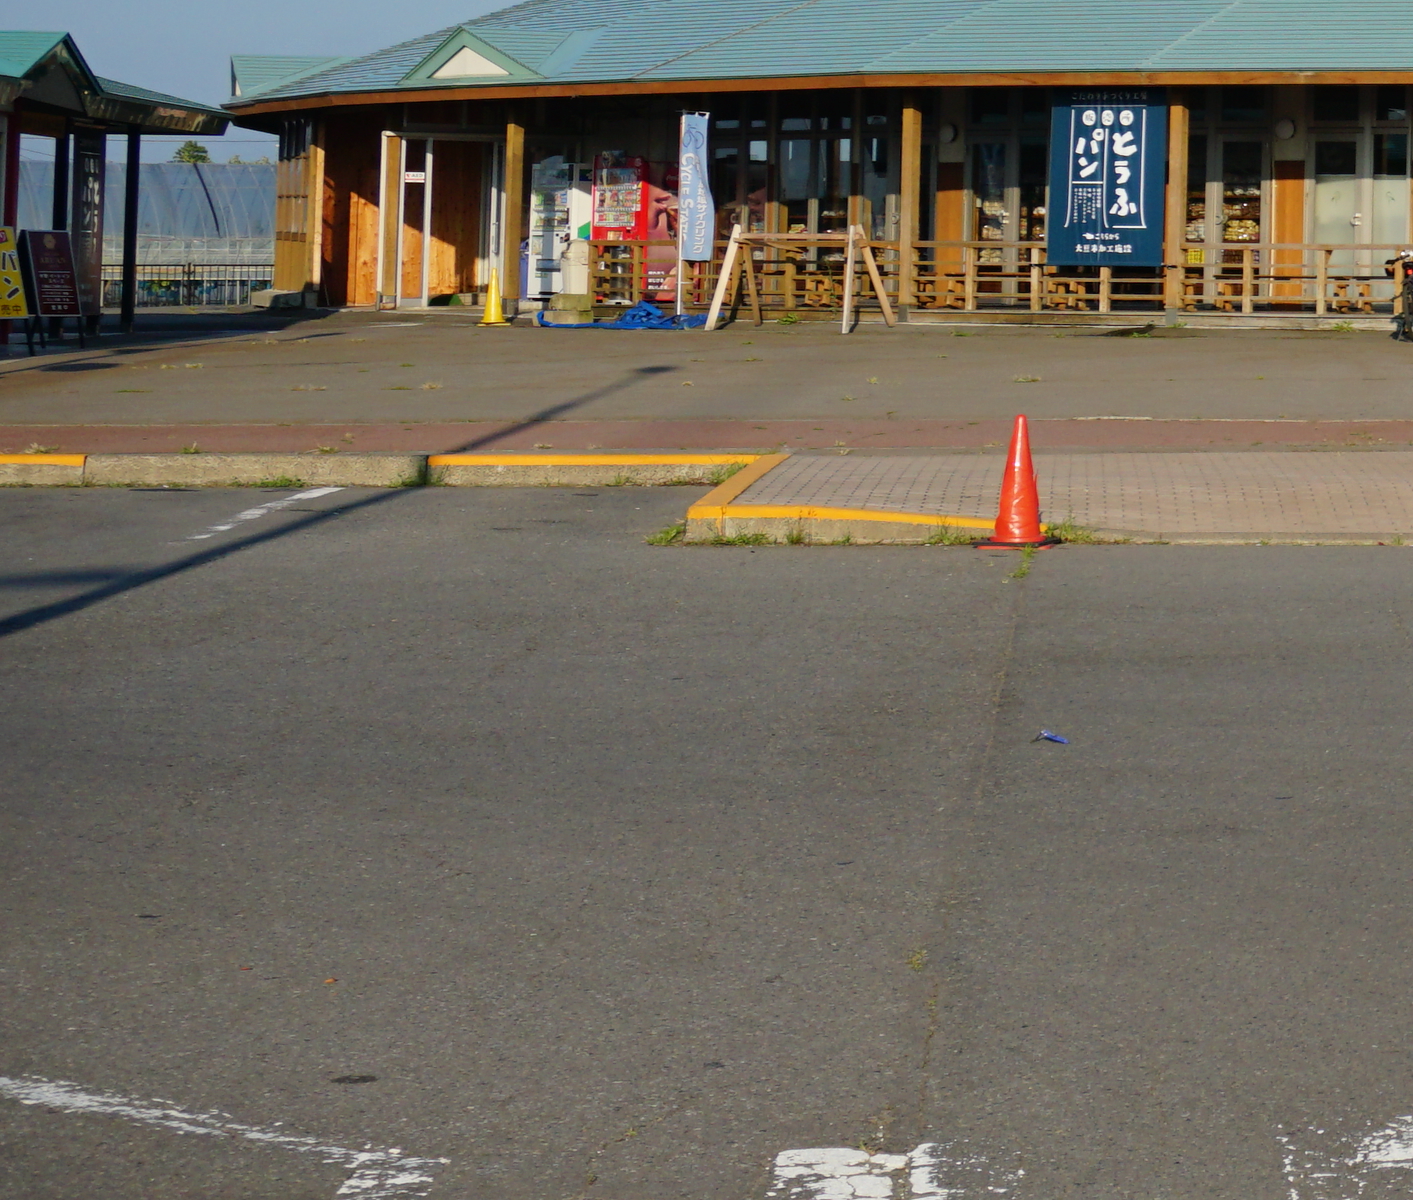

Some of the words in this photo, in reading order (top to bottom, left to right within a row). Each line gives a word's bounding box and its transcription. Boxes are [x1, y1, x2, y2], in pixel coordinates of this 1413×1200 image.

[1075, 128, 1105, 178] パン
[1109, 131, 1138, 216] とうふ
